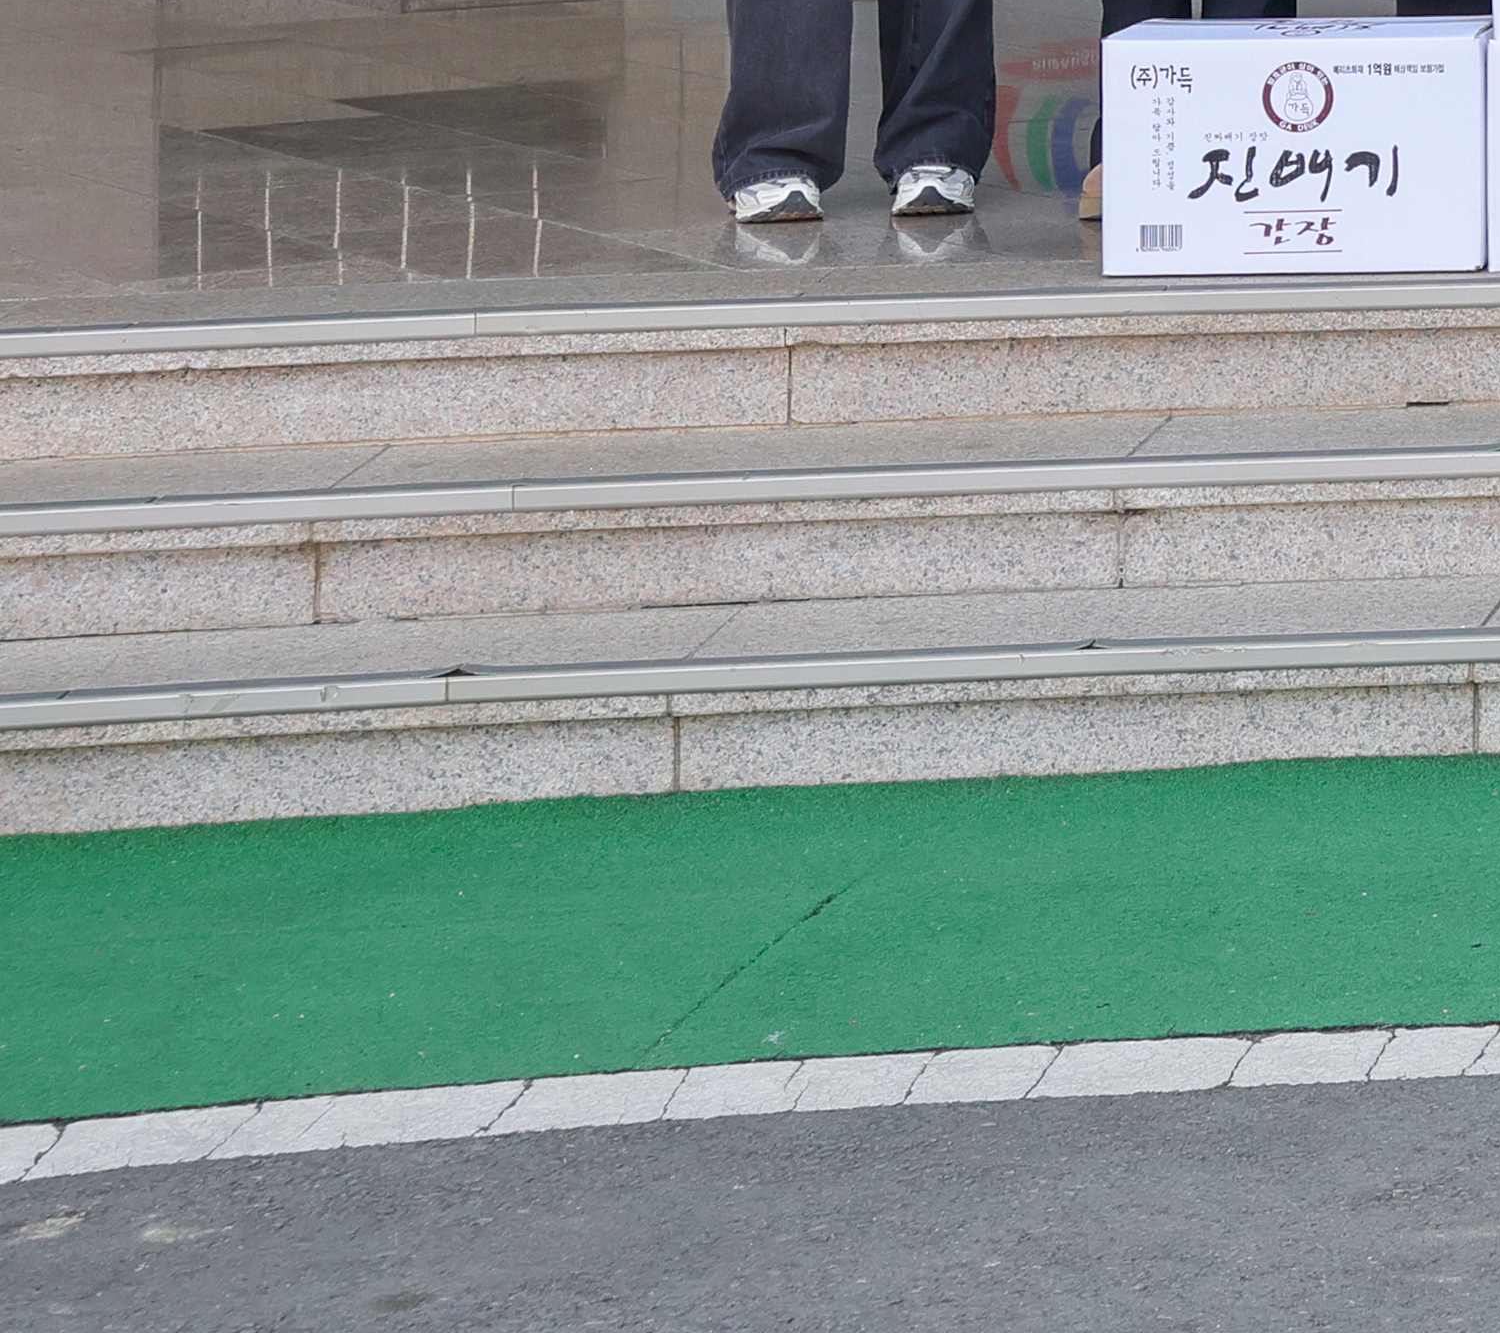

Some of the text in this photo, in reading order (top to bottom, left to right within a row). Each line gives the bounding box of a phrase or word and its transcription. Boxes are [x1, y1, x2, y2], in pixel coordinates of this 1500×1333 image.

[1130, 65, 1193, 94] (주)가득
[1367, 63, 1392, 76] 1억원
[1188, 145, 1400, 203] 진배기
[1248, 217, 1336, 247] 간장
